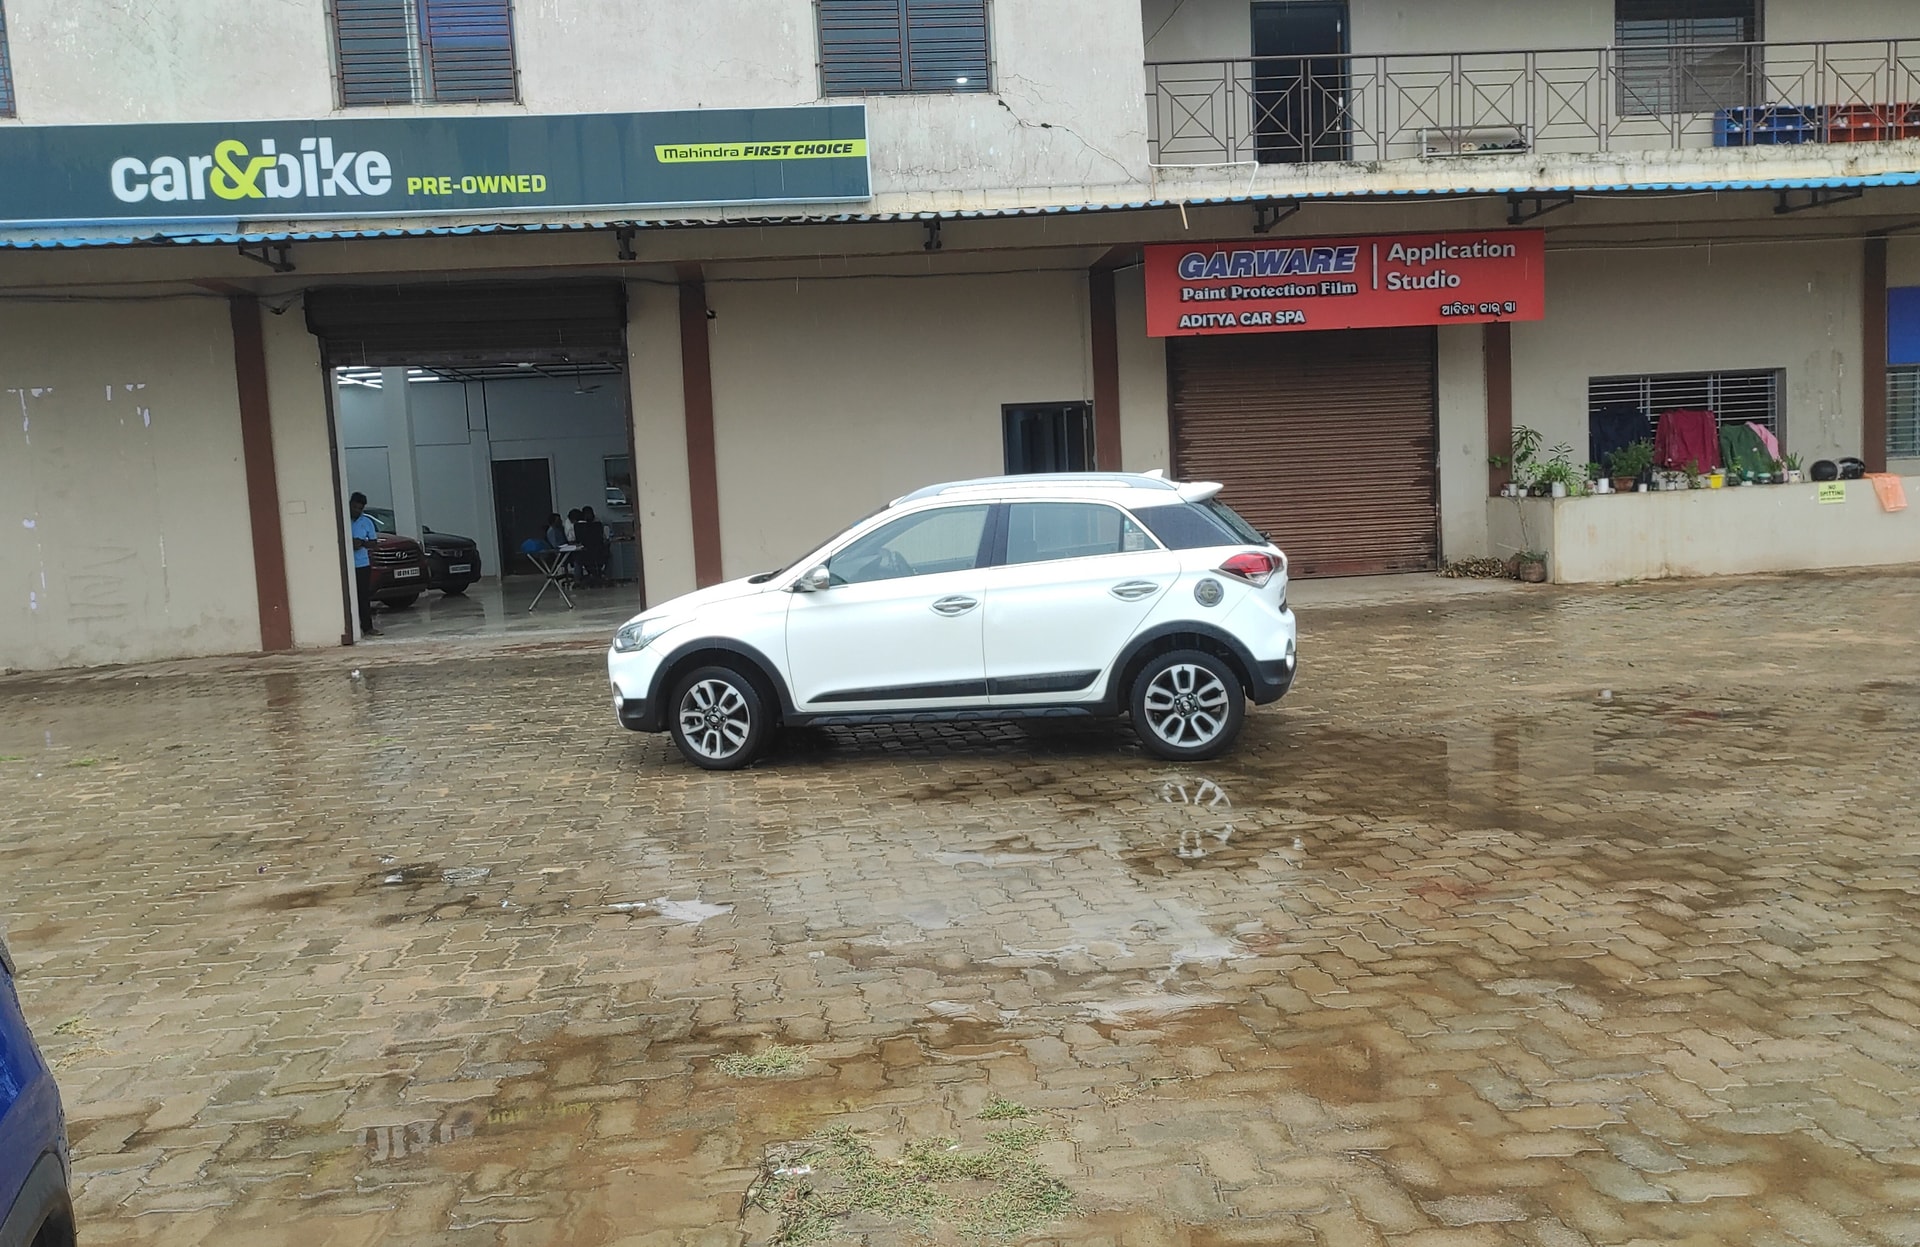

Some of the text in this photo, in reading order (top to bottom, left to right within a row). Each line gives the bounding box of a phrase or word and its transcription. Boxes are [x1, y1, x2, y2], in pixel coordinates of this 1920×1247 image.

[663, 143, 853, 159] Mahindra FIRST CHOICE
[111, 136, 392, 203] car&bike
[407, 174, 547, 196] PRE-OWNED
[1178, 245, 1360, 280] GARWARE
[1387, 239, 1516, 266] Application
[1387, 269, 1461, 290] Studio
[1181, 281, 1357, 301] Paint Protection Film
[1179, 310, 1306, 328] ADITYA CAR SPA
